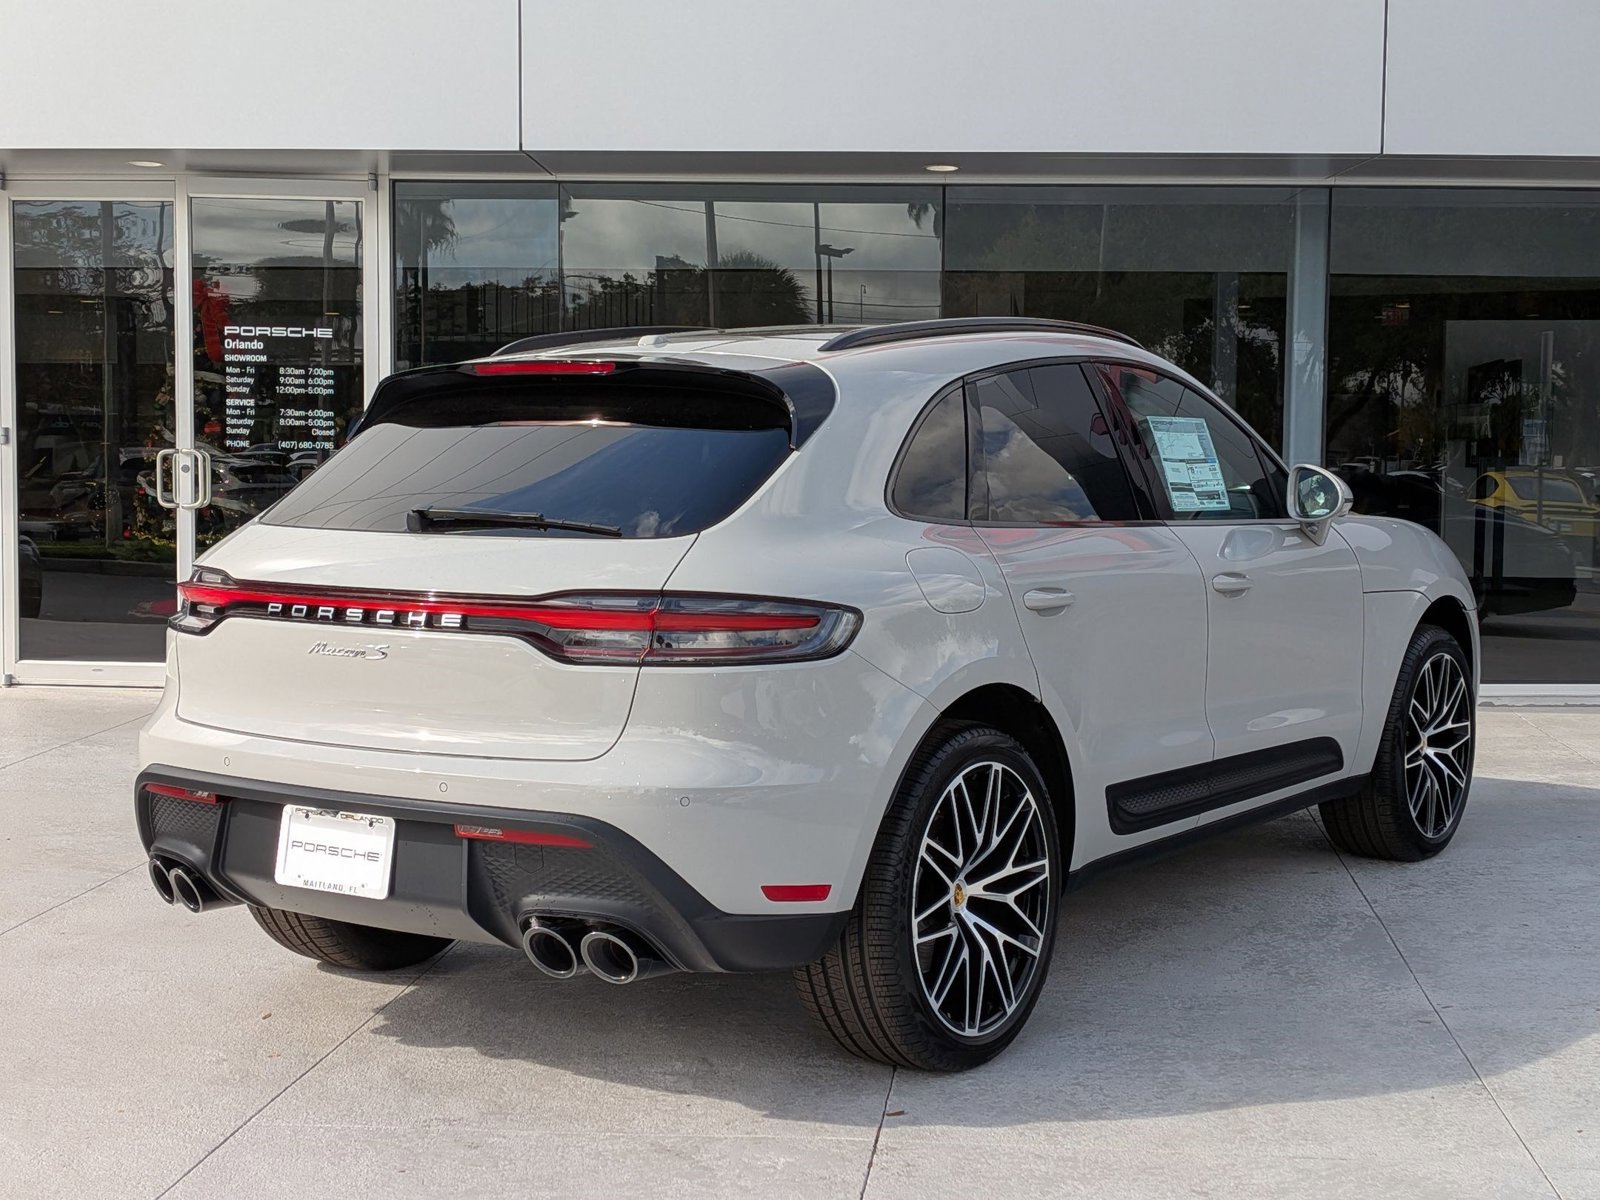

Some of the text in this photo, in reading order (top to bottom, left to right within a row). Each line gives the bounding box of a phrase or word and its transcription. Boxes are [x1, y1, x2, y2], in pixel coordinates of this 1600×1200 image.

[224, 326, 333, 338] PORSCHE
[224, 339, 264, 350] Orlando
[224, 354, 267, 362] SHOWROOM
[308, 368, 334, 376] 7:00pm
[226, 376, 334, 386] Saturday 9:00am 6:00pm
[226, 386, 334, 395] Sunday 12:00pm-5:00pm
[226, 398, 255, 406] SERVICE
[279, 408, 334, 418] 7:30am-6:00pm
[226, 418, 254, 426] Saturday
[226, 427, 334, 436] Sunday Closed
[226, 440, 250, 448] PHONE
[278, 441, 298, 450] (407)
[268, 602, 462, 627] PORSCHE
[307, 640, 390, 660] Macan S
[340, 813, 384, 824] ORLANDO
[291, 840, 380, 862] PORSCHE
